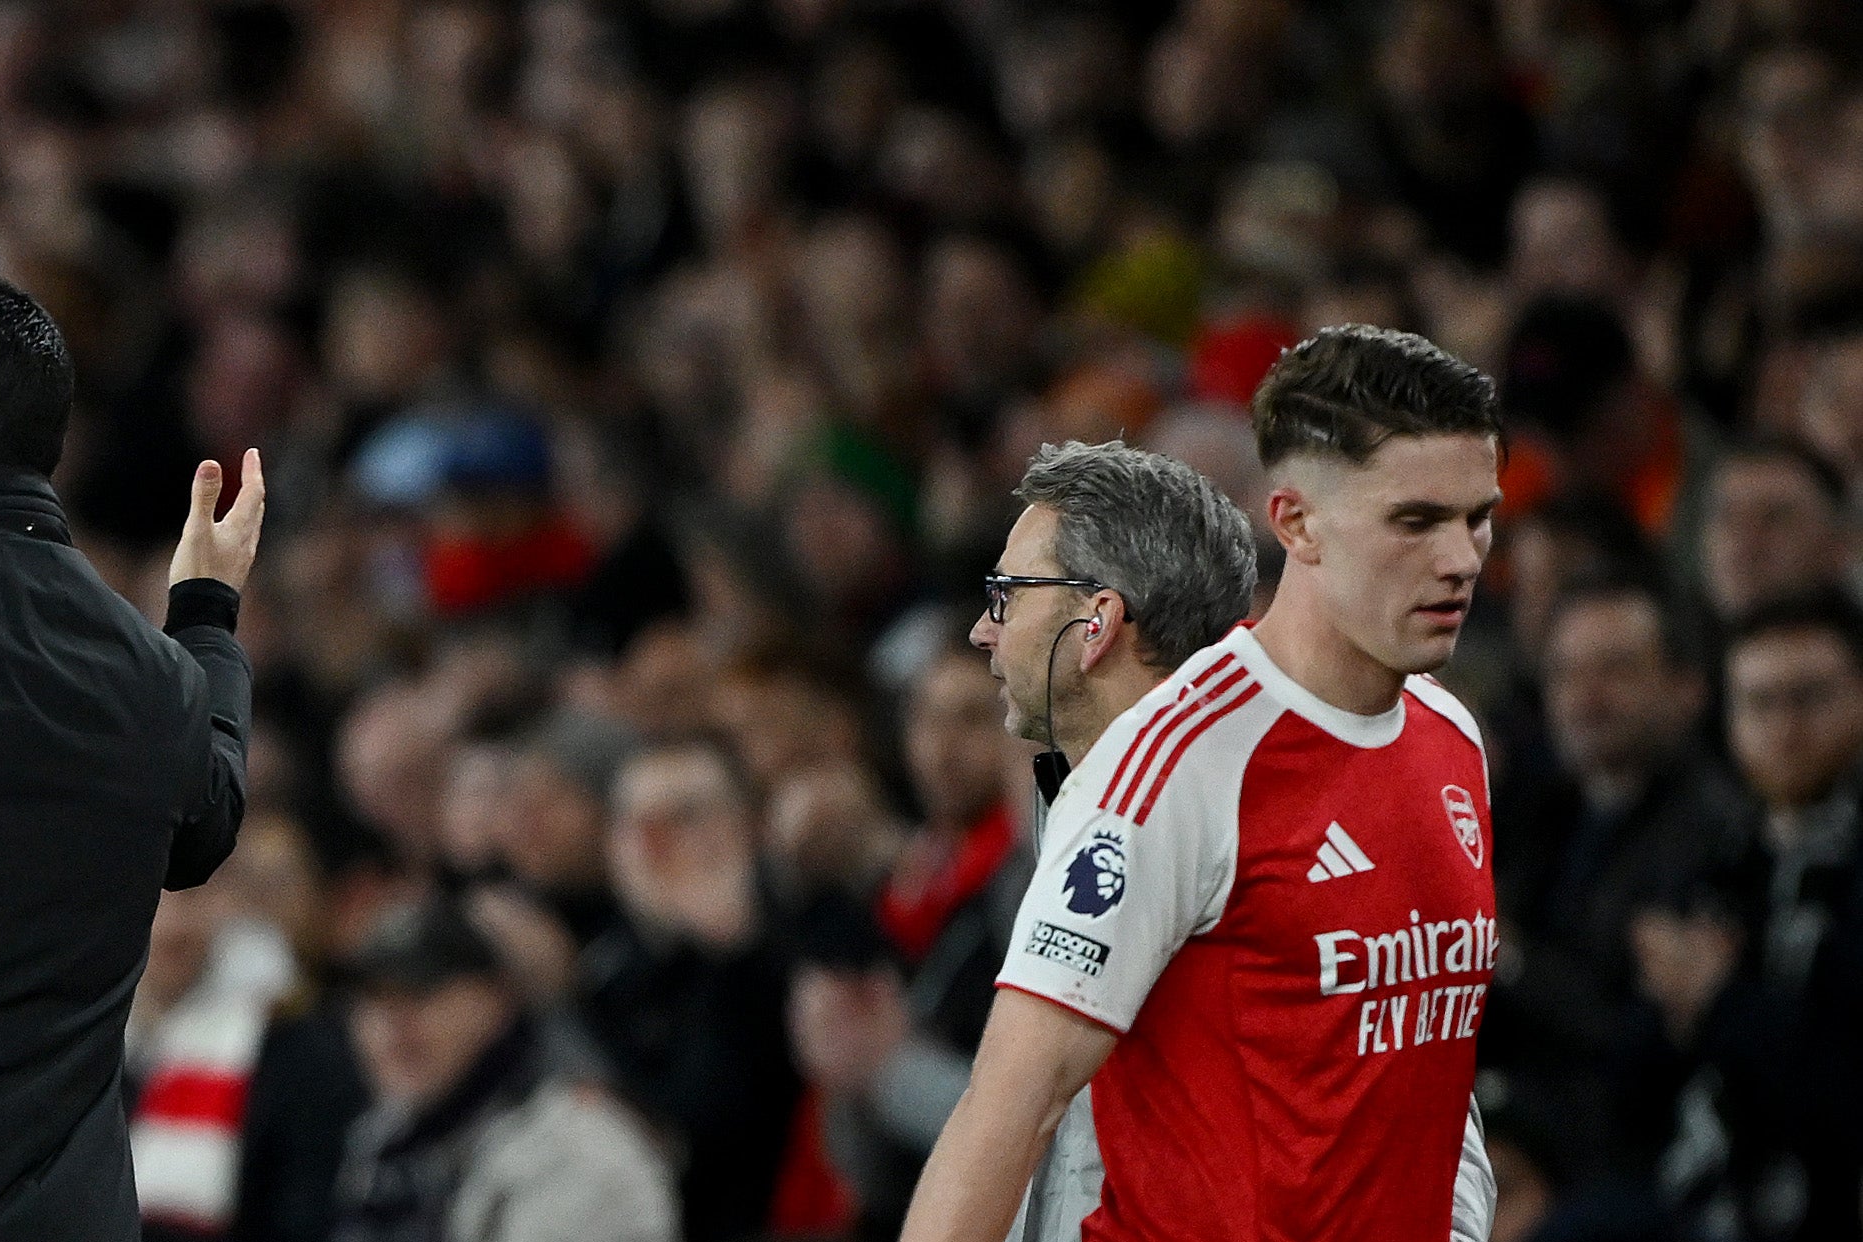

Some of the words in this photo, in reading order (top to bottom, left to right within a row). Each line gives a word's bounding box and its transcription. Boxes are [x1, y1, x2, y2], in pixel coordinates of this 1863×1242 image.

[1313, 909, 1500, 996] Emirate
[1358, 995, 1409, 1057] FLY
[1414, 984, 1487, 1046] BETTE
